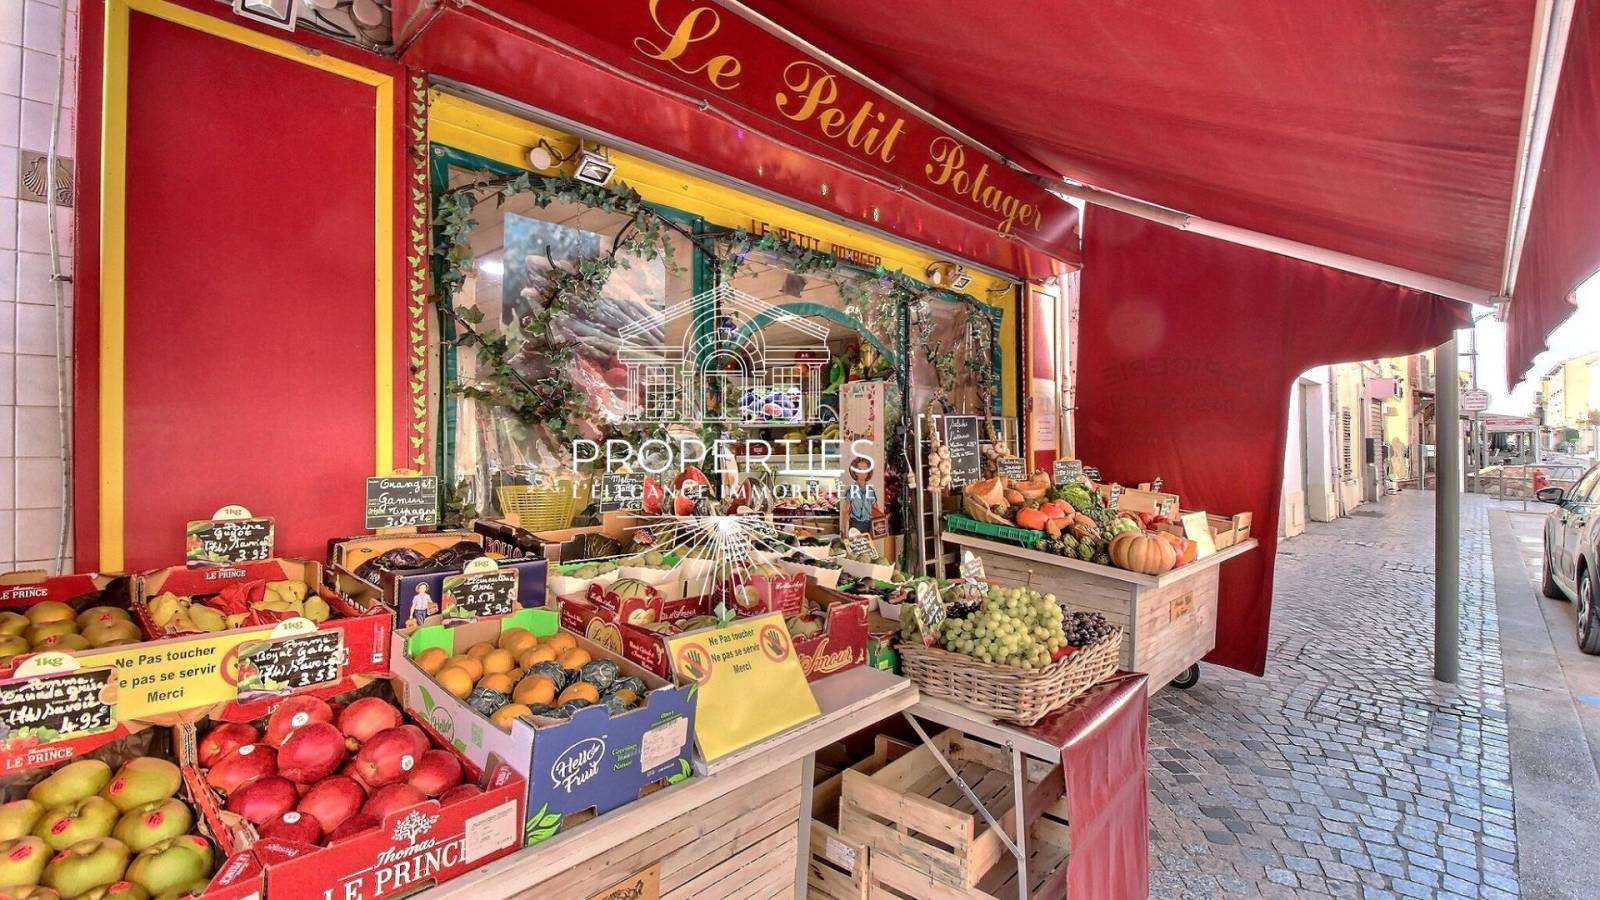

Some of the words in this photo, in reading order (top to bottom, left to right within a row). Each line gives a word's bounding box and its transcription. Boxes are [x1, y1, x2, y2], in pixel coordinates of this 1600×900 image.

[633, 0, 741, 90] Le
[775, 60, 906, 163] Petit
[925, 136, 1042, 237] Potager
[206, 571, 217, 580] LE
[218, 569, 247, 579] PRINCE
[12, 588, 48, 599] PRINCE
[708, 637, 719, 646] Ne
[720, 634, 731, 643] Pas
[732, 629, 754, 641] toucher
[34, 657, 64, 667] 1kg
[115, 658, 134, 669] Ne
[138, 654, 162, 666] Pas
[167, 646, 216, 661] toucher
[711, 653, 721, 663] Ne
[722, 650, 734, 662] pas
[735, 648, 743, 656] se
[743, 643, 760, 655] servir
[132, 675, 156, 689] pas
[160, 672, 175, 682] se
[180, 663, 217, 678] servir
[733, 661, 752, 674] Merci
[147, 686, 185, 703] Merci
[7, 757, 23, 769] LE
[28, 747, 73, 765] PRINCE
[556, 743, 600, 778] Hello
[561, 763, 599, 793] Fruit
[373, 837, 437, 869] Thomas
